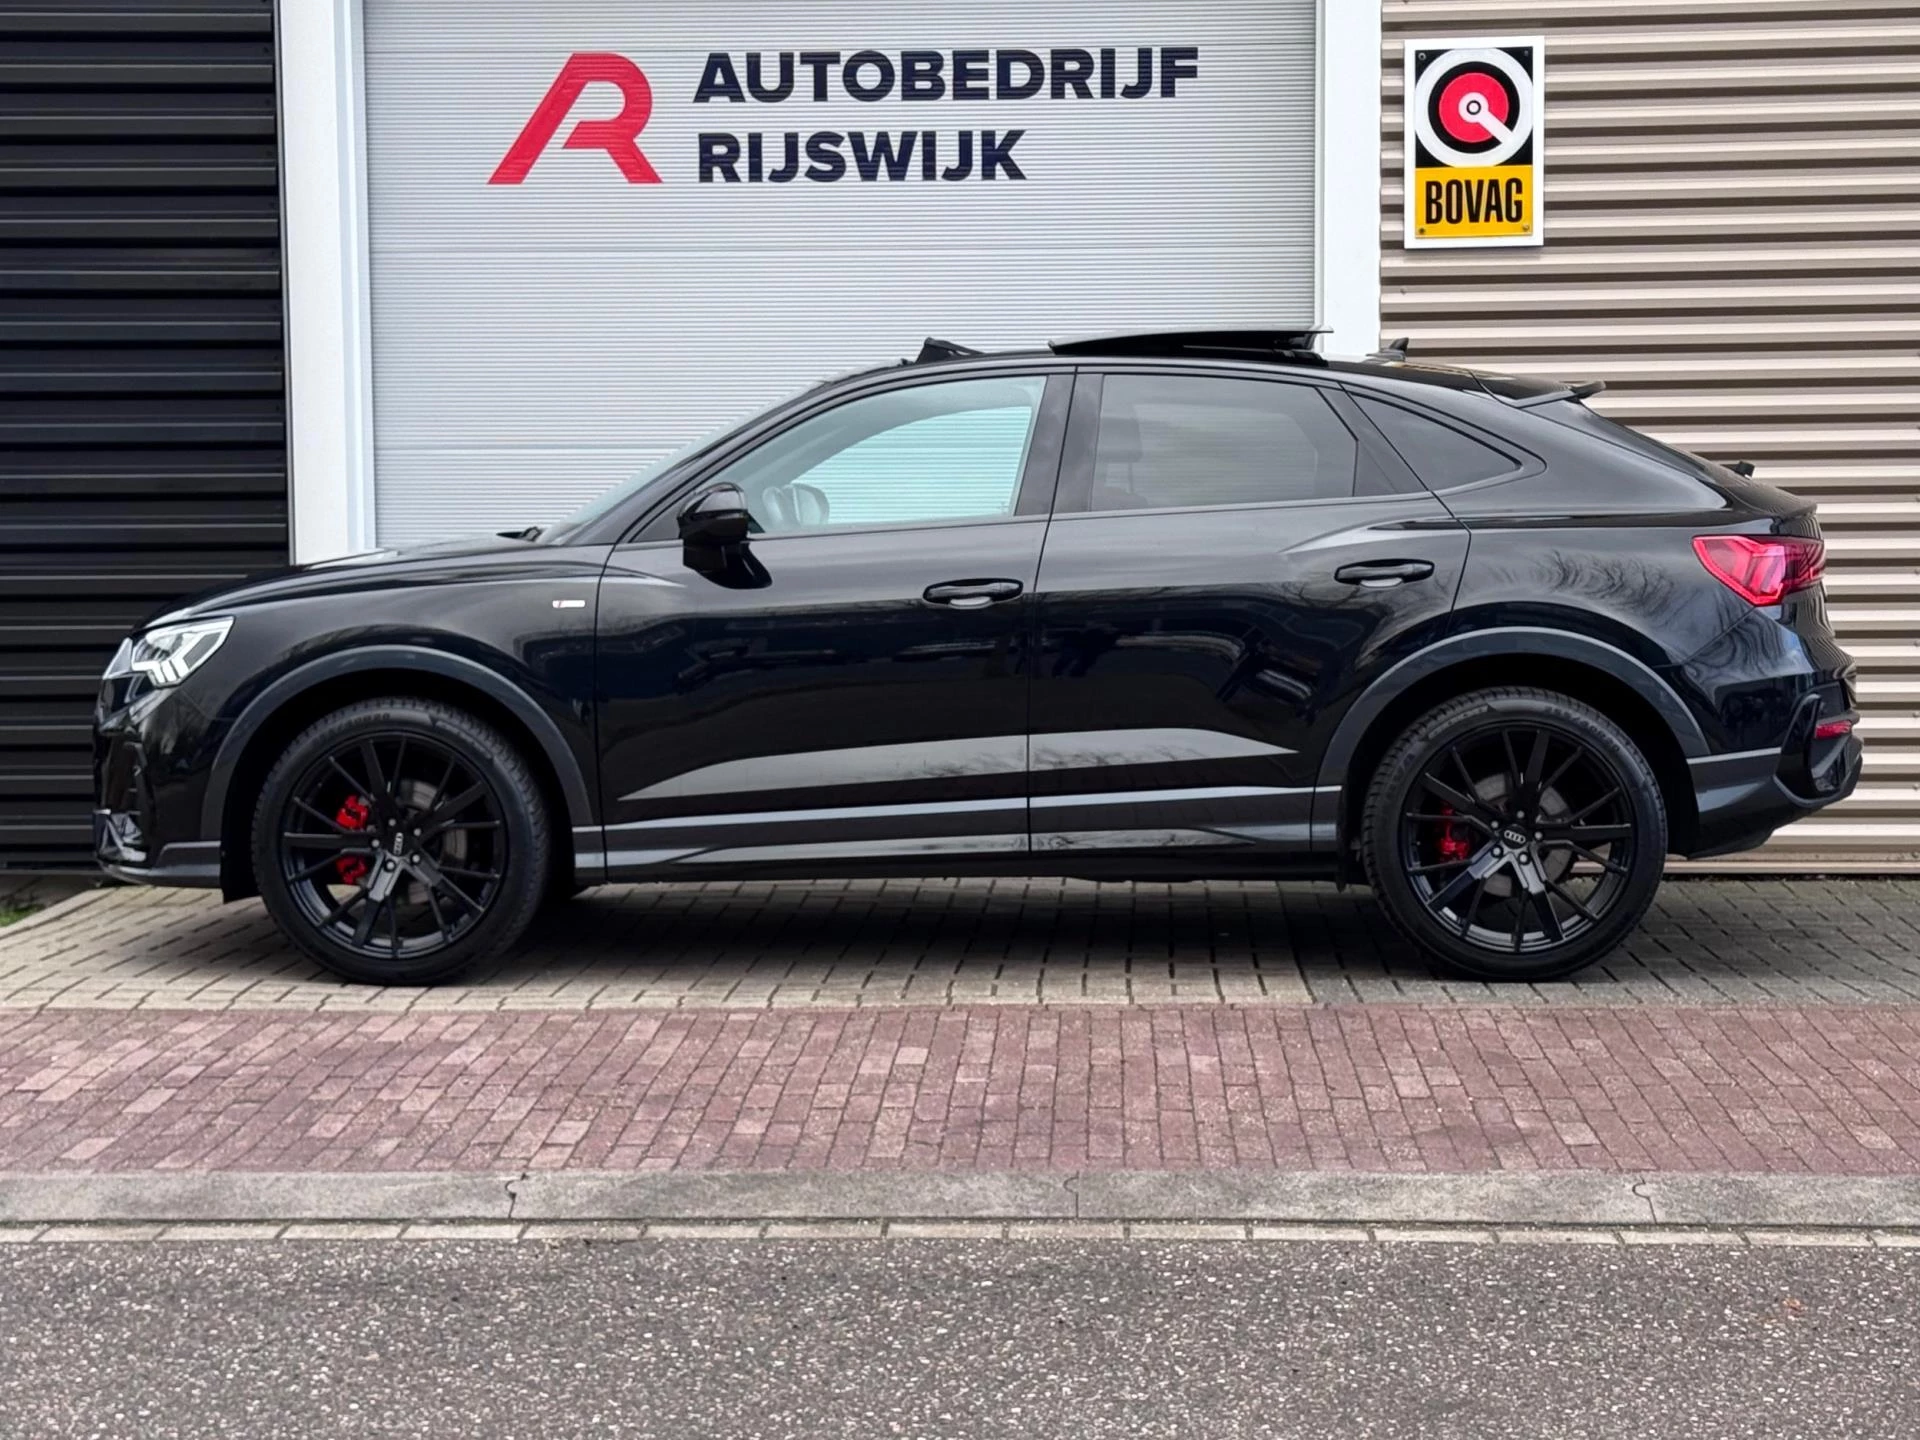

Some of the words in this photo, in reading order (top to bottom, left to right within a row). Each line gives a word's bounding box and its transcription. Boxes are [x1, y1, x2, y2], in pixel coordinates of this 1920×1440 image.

[694, 47, 1198, 102] AUTOBEDRIJF
[699, 130, 1026, 182] RIJSWIJK
[1426, 178, 1522, 224] BOVAG
